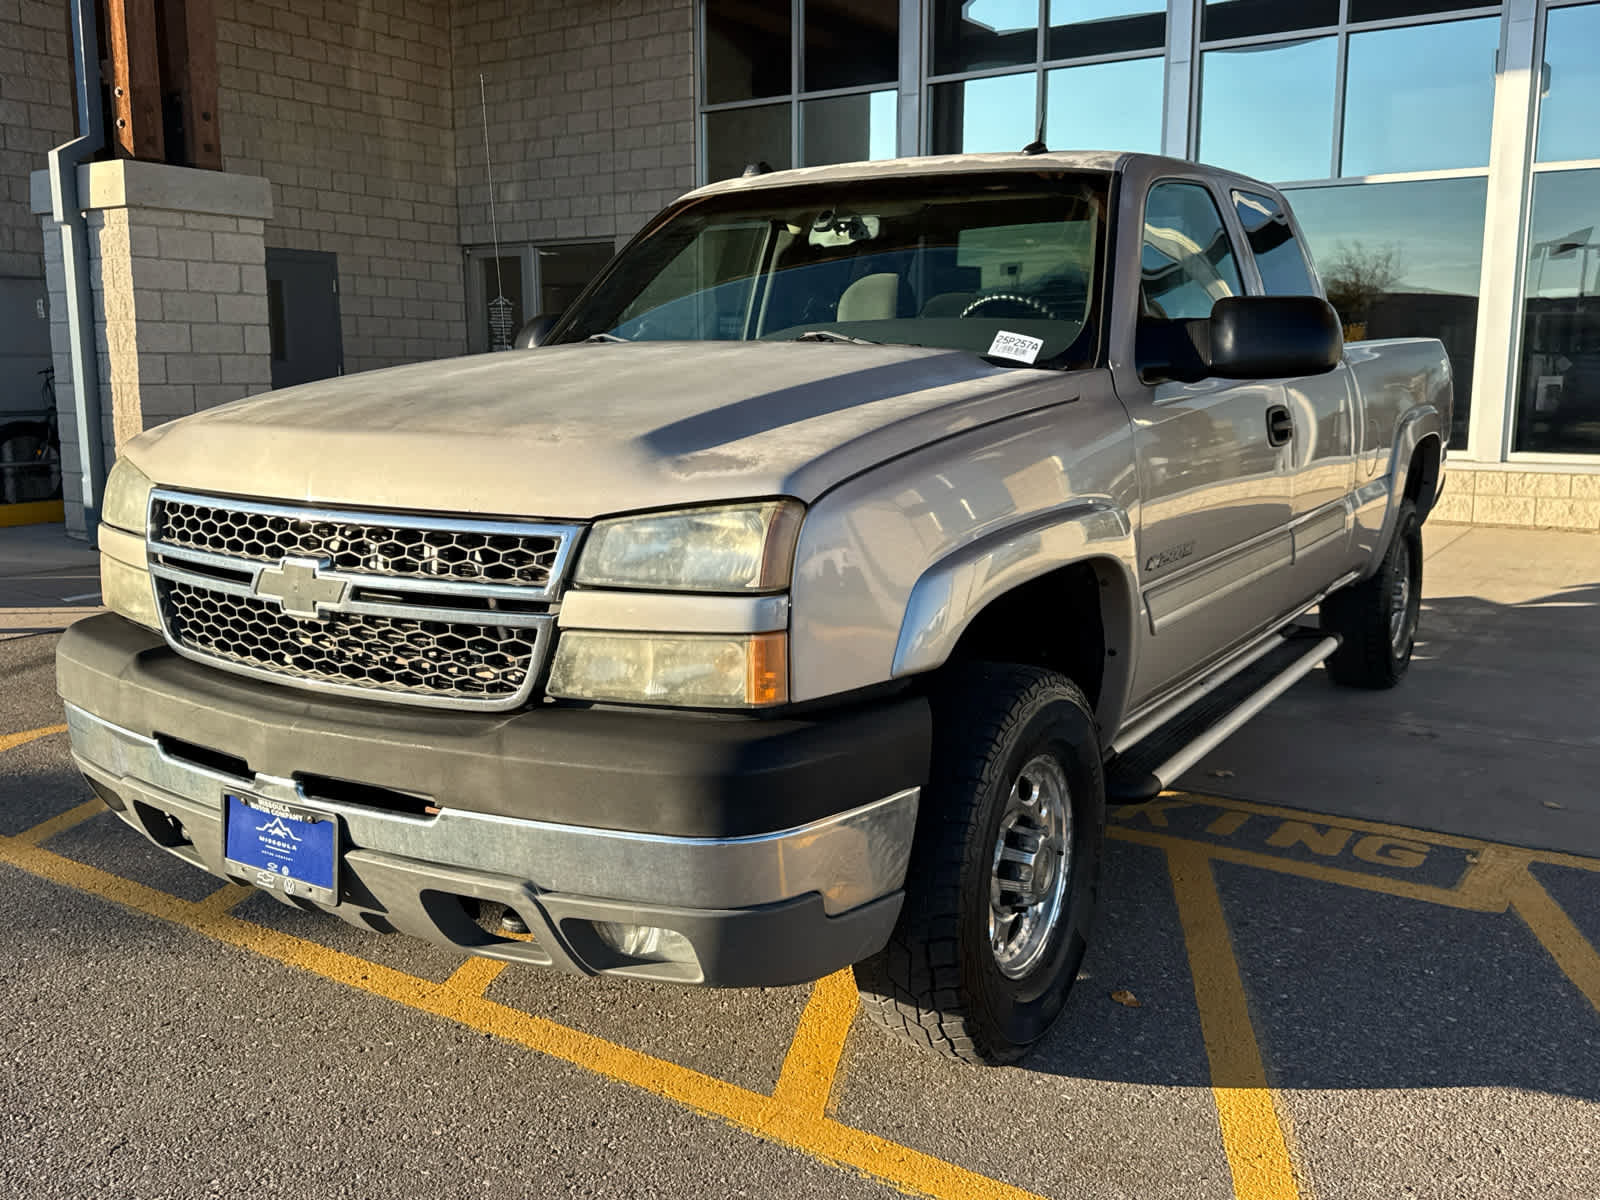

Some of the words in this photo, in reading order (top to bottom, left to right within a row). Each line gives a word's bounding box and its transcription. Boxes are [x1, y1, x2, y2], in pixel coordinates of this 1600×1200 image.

[996, 335, 1039, 351] 25P257A
[258, 799, 290, 812] MISSOULA
[259, 836, 297, 851] MISSOULA
